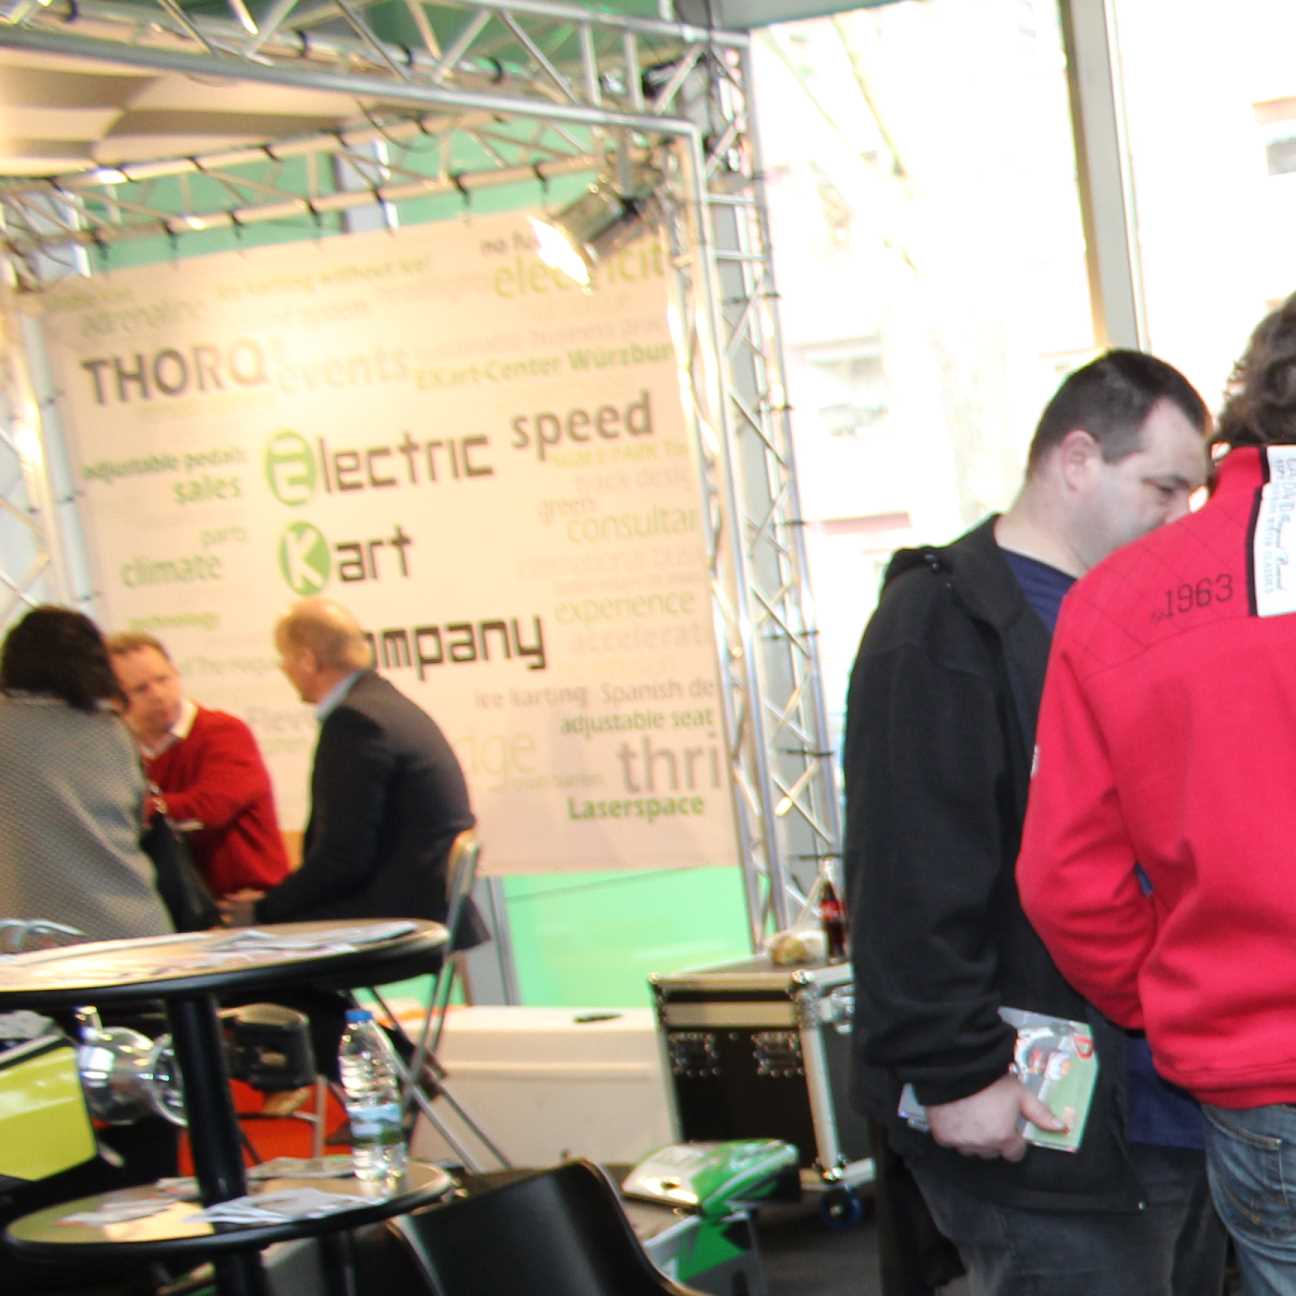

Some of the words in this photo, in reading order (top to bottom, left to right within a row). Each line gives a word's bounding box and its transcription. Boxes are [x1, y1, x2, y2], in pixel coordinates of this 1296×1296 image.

[509, 387, 655, 463] speed
[276, 519, 414, 599] Kart
[553, 588, 696, 626] experience
[1164, 573, 1235, 619] 1963
[600, 677, 683, 708] Spanish
[559, 707, 664, 741] adjustable
[671, 706, 714, 727] seat
[565, 794, 705, 825] Laserspace
